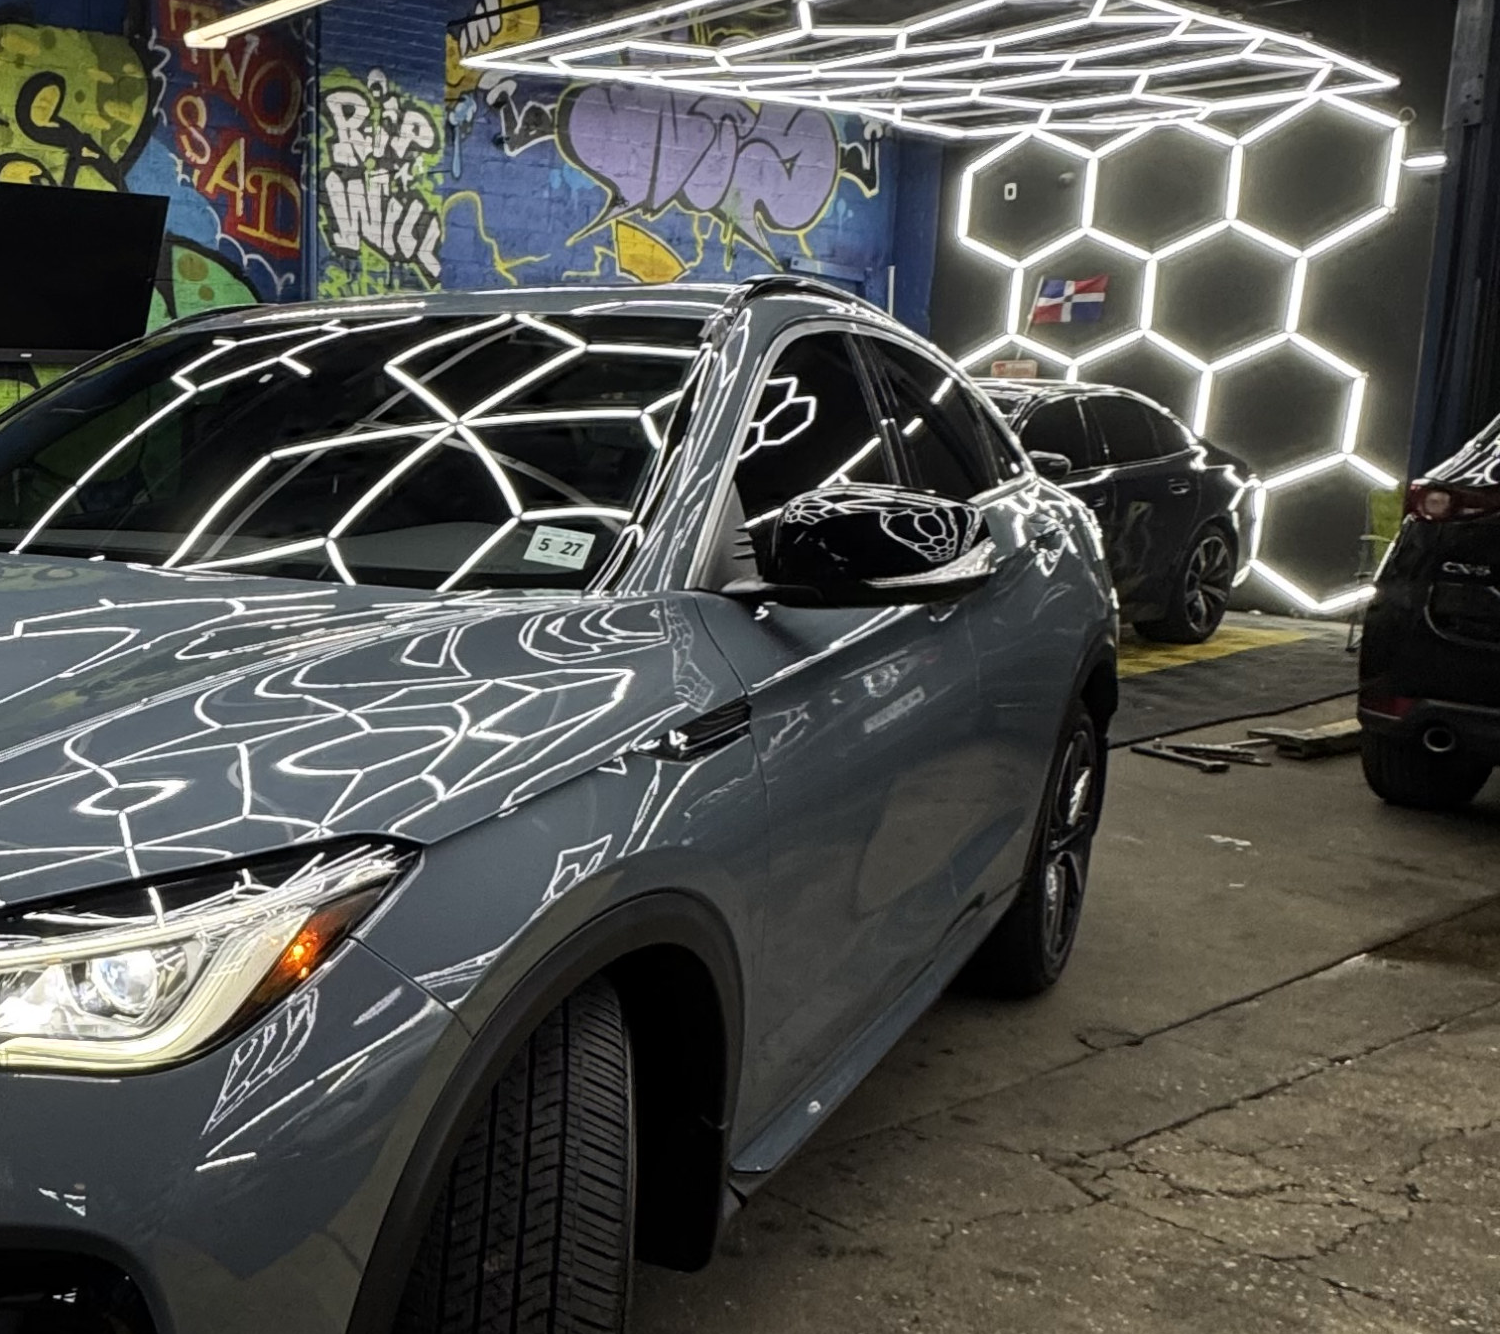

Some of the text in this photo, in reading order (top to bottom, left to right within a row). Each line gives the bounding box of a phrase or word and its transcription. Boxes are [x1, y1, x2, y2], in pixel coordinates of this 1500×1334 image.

[325, 70, 435, 167] RIP
[538, 538, 584, 556] 5 27
